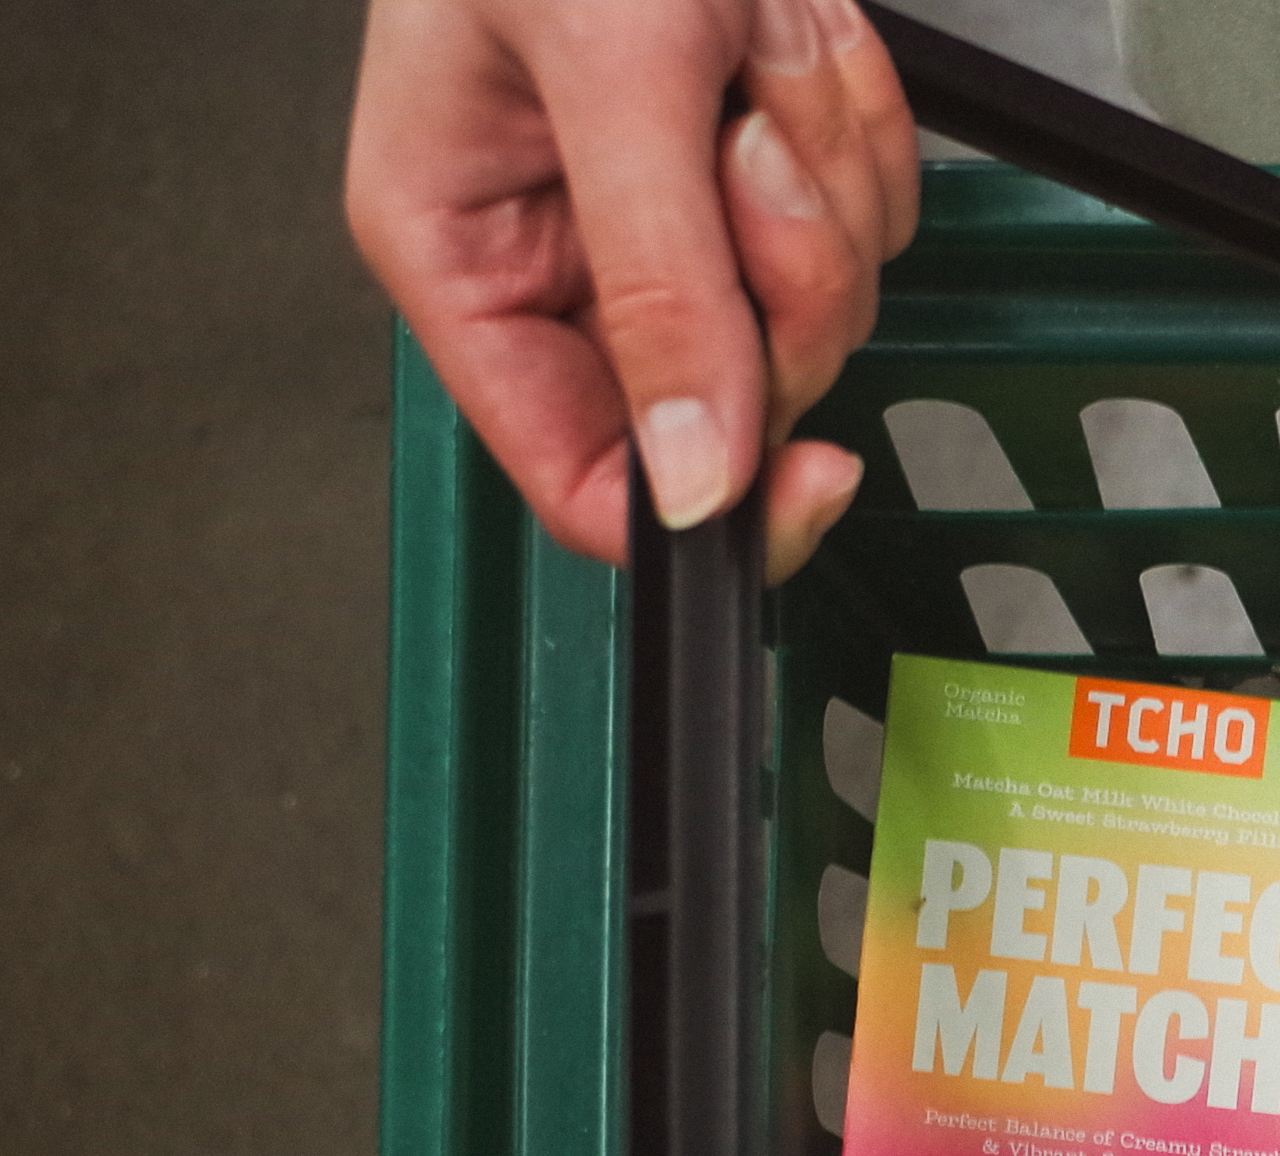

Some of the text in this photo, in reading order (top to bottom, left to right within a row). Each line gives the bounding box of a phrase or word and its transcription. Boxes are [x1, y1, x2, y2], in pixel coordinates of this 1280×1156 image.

[944, 683, 1026, 708] Organic
[944, 701, 1022, 726] Matcha
[1088, 690, 1256, 765] TCHO
[952, 773, 1031, 796] Matcha
[1037, 783, 1075, 801] Oat
[1082, 787, 1133, 809] Milk
[1140, 794, 1206, 816] White
[1008, 802, 1025, 818] A
[1031, 804, 1094, 827] Sweet
[1102, 813, 1229, 846] Strawberry
[924, 1109, 998, 1132] Perfect
[1006, 1118, 1086, 1143] Balance
[1093, 1130, 1115, 1146] of
[982, 1138, 999, 1156] &
